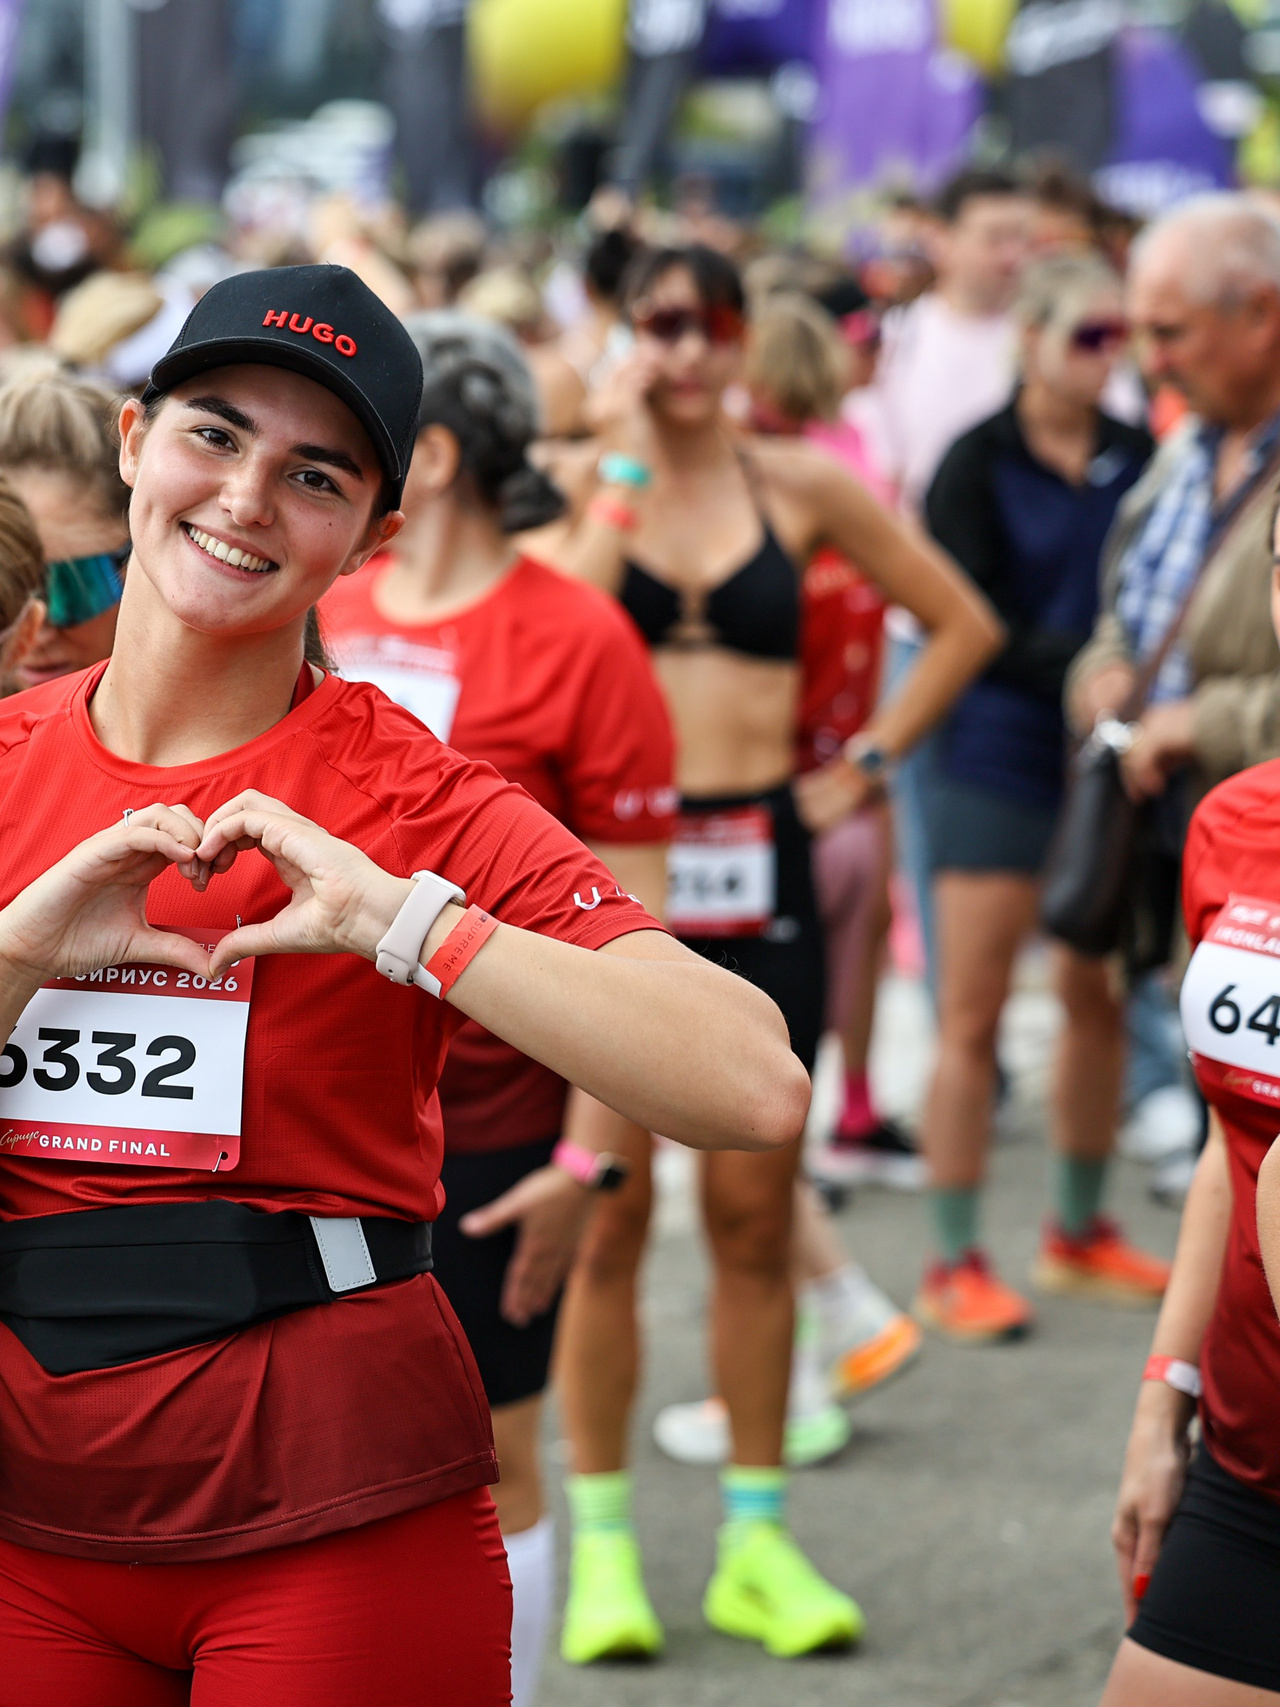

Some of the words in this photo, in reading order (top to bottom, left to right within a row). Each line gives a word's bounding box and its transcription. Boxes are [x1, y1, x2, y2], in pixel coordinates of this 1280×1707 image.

[262, 309, 357, 357] HUGO
[443, 921, 483, 971] SUPREME
[176, 972, 238, 992] 2026
[39, 1135, 102, 1151] GRAND
[109, 1140, 170, 1156] FINAL
